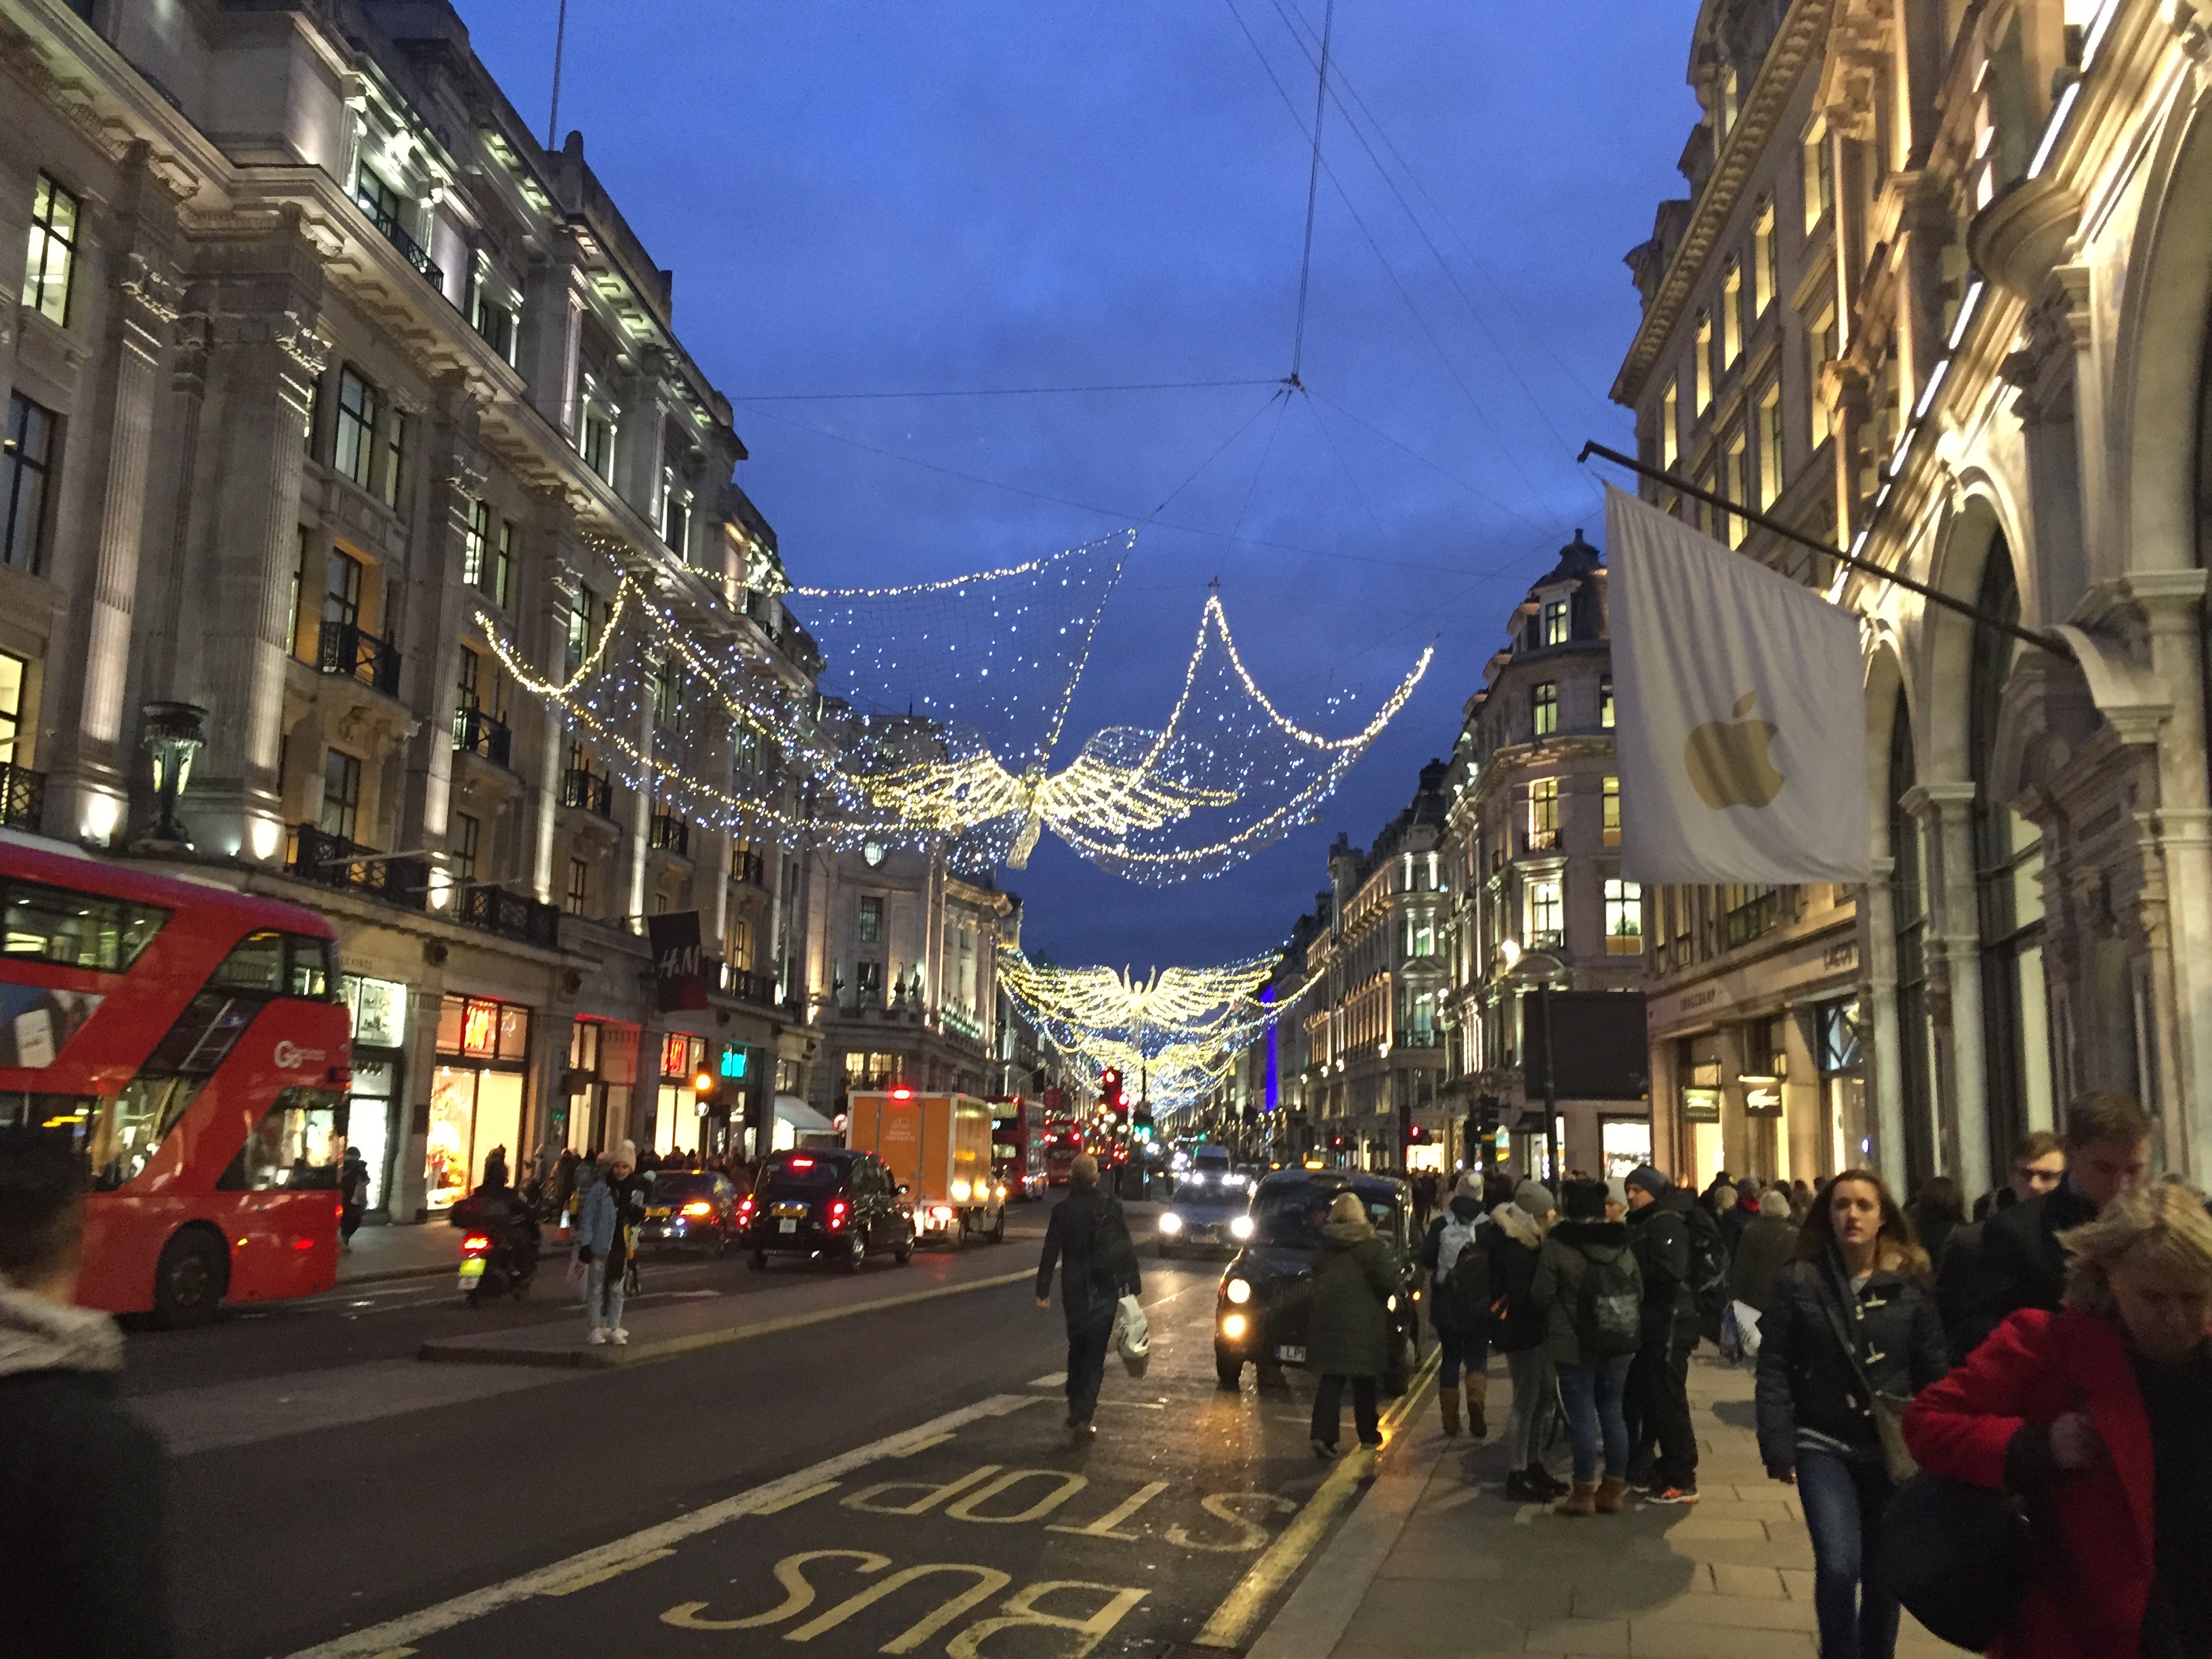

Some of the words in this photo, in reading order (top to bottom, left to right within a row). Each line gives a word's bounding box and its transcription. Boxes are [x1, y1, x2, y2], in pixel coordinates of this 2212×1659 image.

[659, 944, 700, 978] H&M
[840, 1465, 1297, 1552] STOP
[659, 1550, 1152, 1659] BUS
